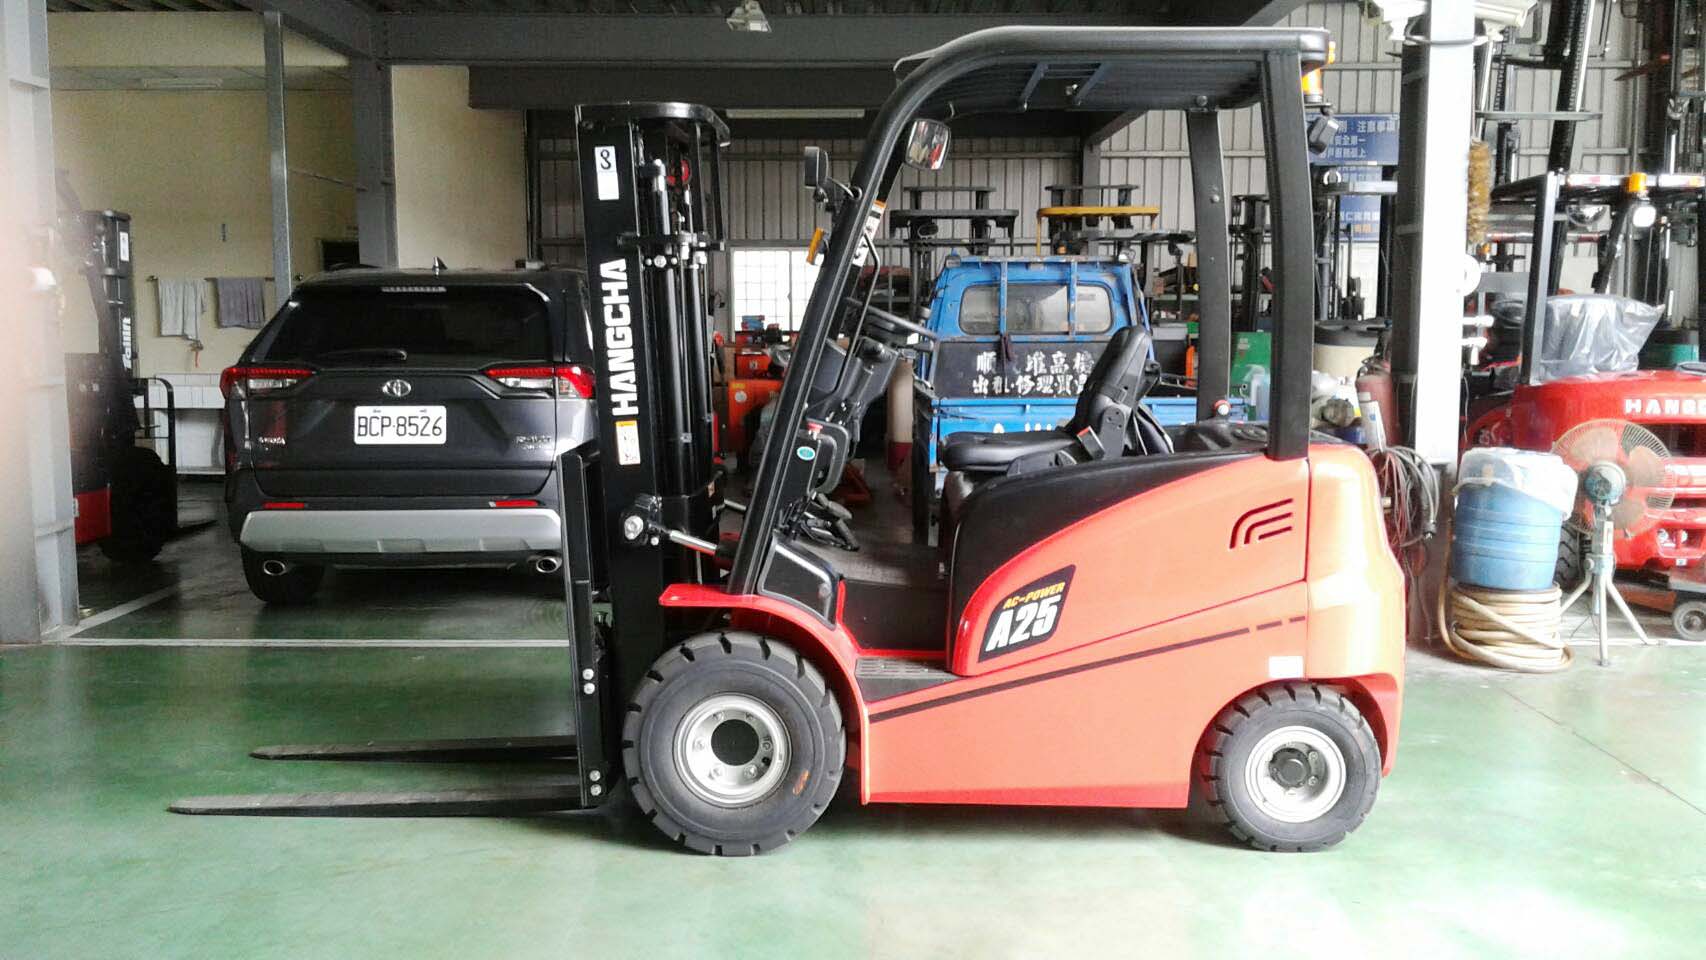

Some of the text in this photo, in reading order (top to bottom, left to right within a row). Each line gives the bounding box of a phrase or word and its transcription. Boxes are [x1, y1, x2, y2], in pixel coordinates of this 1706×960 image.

[600, 259, 639, 416] HANGCHA
[976, 351, 1095, 376] 順堆高機
[1003, 582, 1066, 610] AC-POWER
[985, 594, 1062, 652] A25
